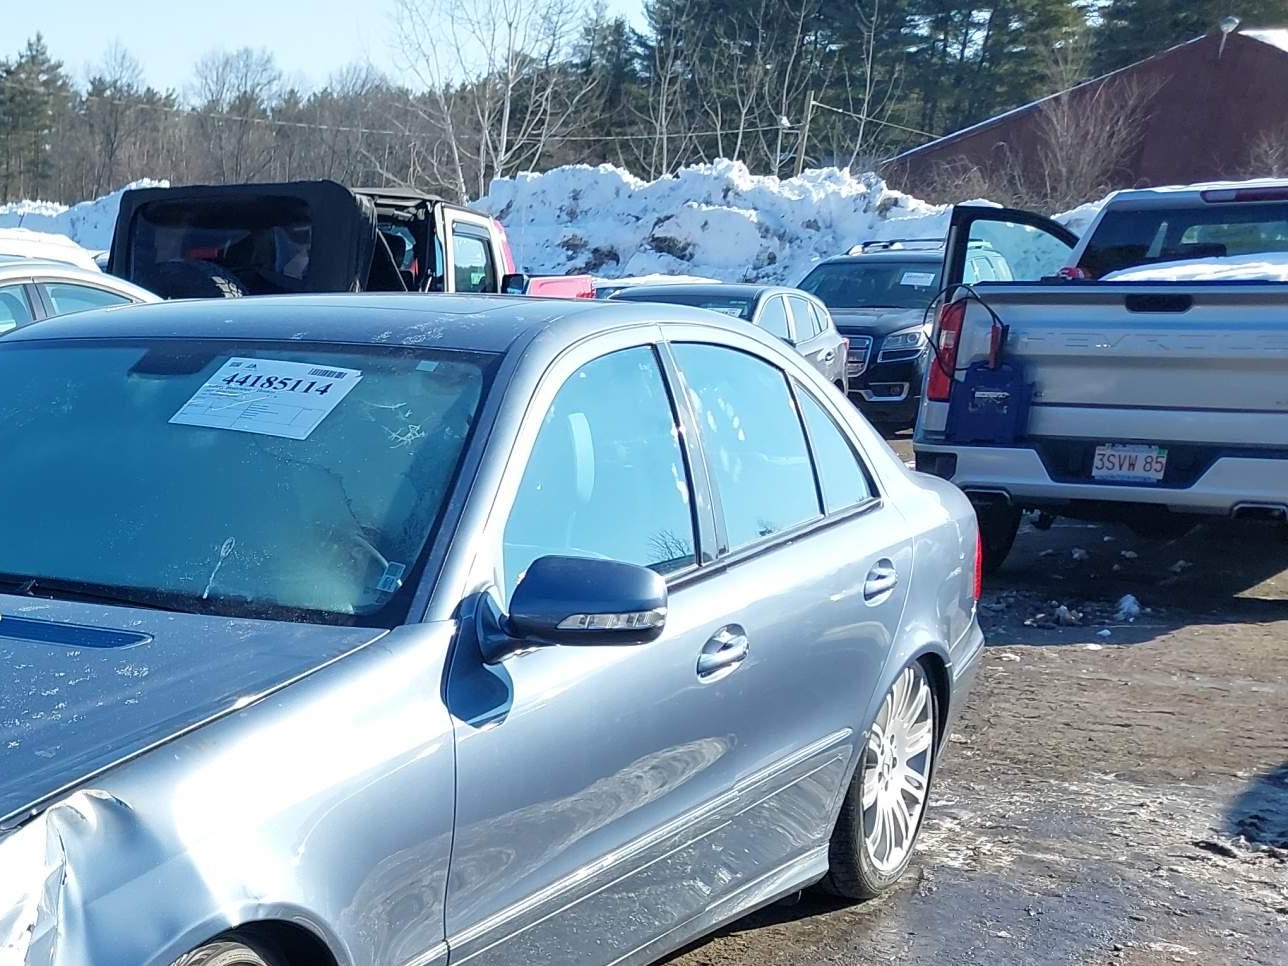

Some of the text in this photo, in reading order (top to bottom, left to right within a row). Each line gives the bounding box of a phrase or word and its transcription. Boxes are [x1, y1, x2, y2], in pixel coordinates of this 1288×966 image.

[221, 372, 335, 396] 44185114
[1095, 453, 1165, 473] 3SVW 85
